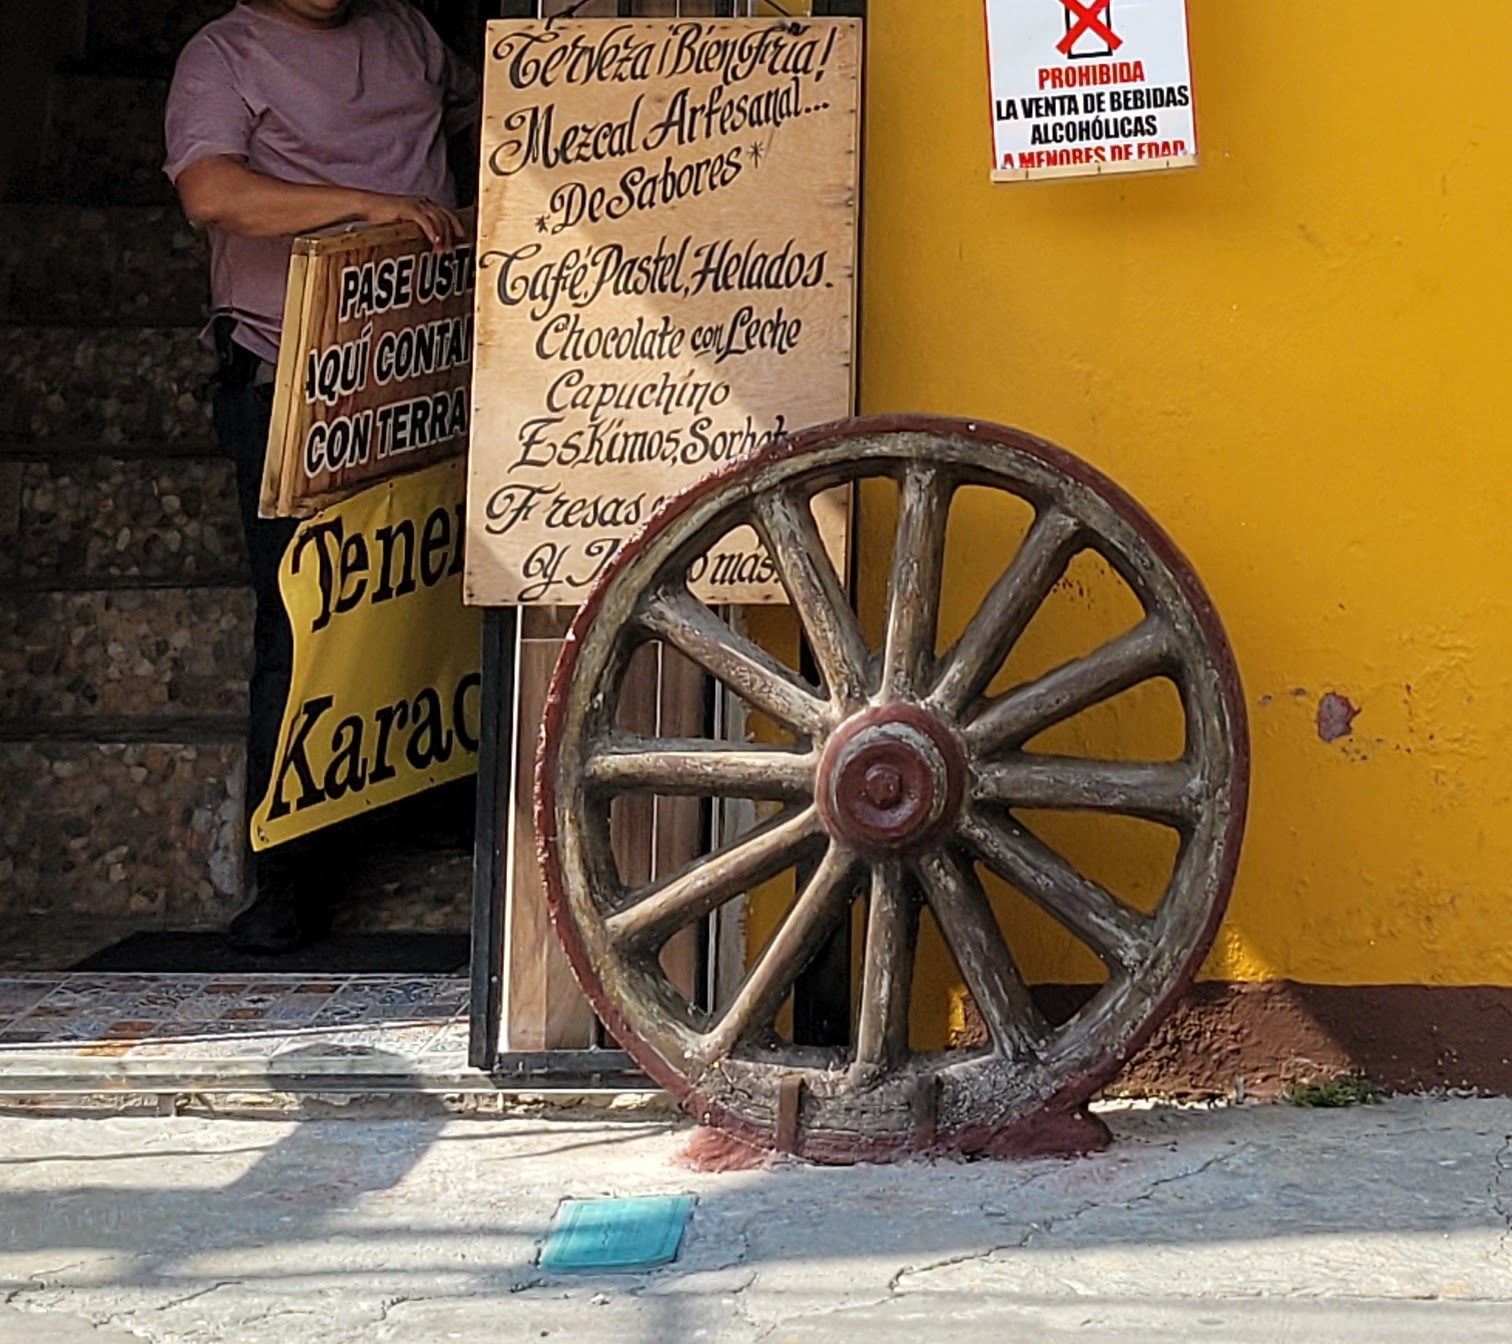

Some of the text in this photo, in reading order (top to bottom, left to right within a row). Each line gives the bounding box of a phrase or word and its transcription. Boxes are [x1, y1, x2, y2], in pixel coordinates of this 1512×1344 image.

[1038, 61, 1145, 90] PROHIBIDA
[995, 85, 1189, 121] LA VENTA DE BEBIDAS
[1030, 114, 1158, 145] ALCOHÓLICAS
[489, 92, 646, 177] Mezcal
[1003, 153, 1014, 168] A
[1018, 146, 1107, 169] MENORES
[1110, 143, 1133, 162] DE
[339, 254, 415, 322] PASE
[535, 305, 802, 364] Chocolate con Leche
[546, 368, 731, 421] Capuchino
[305, 410, 373, 479] CON
[485, 482, 646, 535] Fresas
